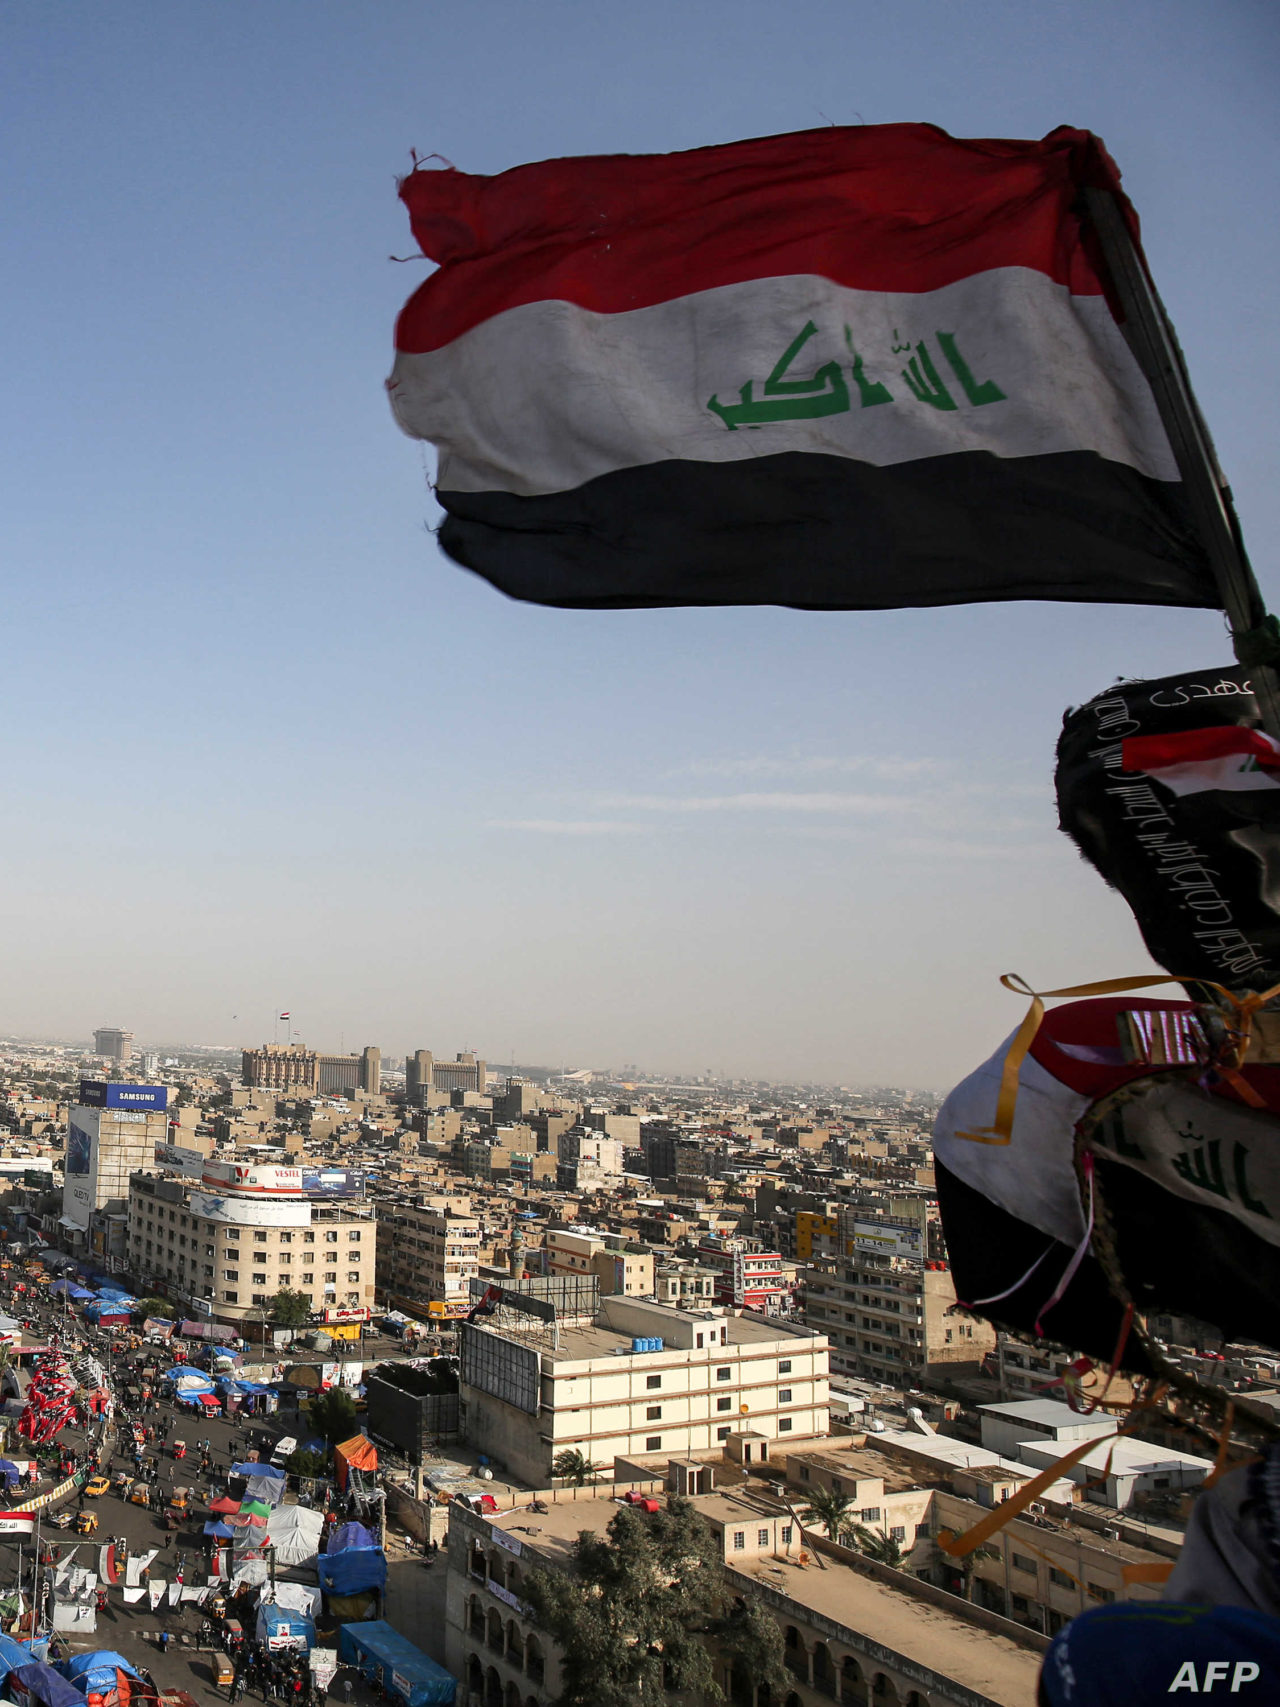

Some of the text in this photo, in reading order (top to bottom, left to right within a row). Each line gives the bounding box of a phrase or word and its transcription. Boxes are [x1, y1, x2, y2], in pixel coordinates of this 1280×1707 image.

[891, 328, 1008, 408] الله
[119, 1092, 155, 1101] SAMSUNG
[275, 1170, 300, 1178] VESTEL
